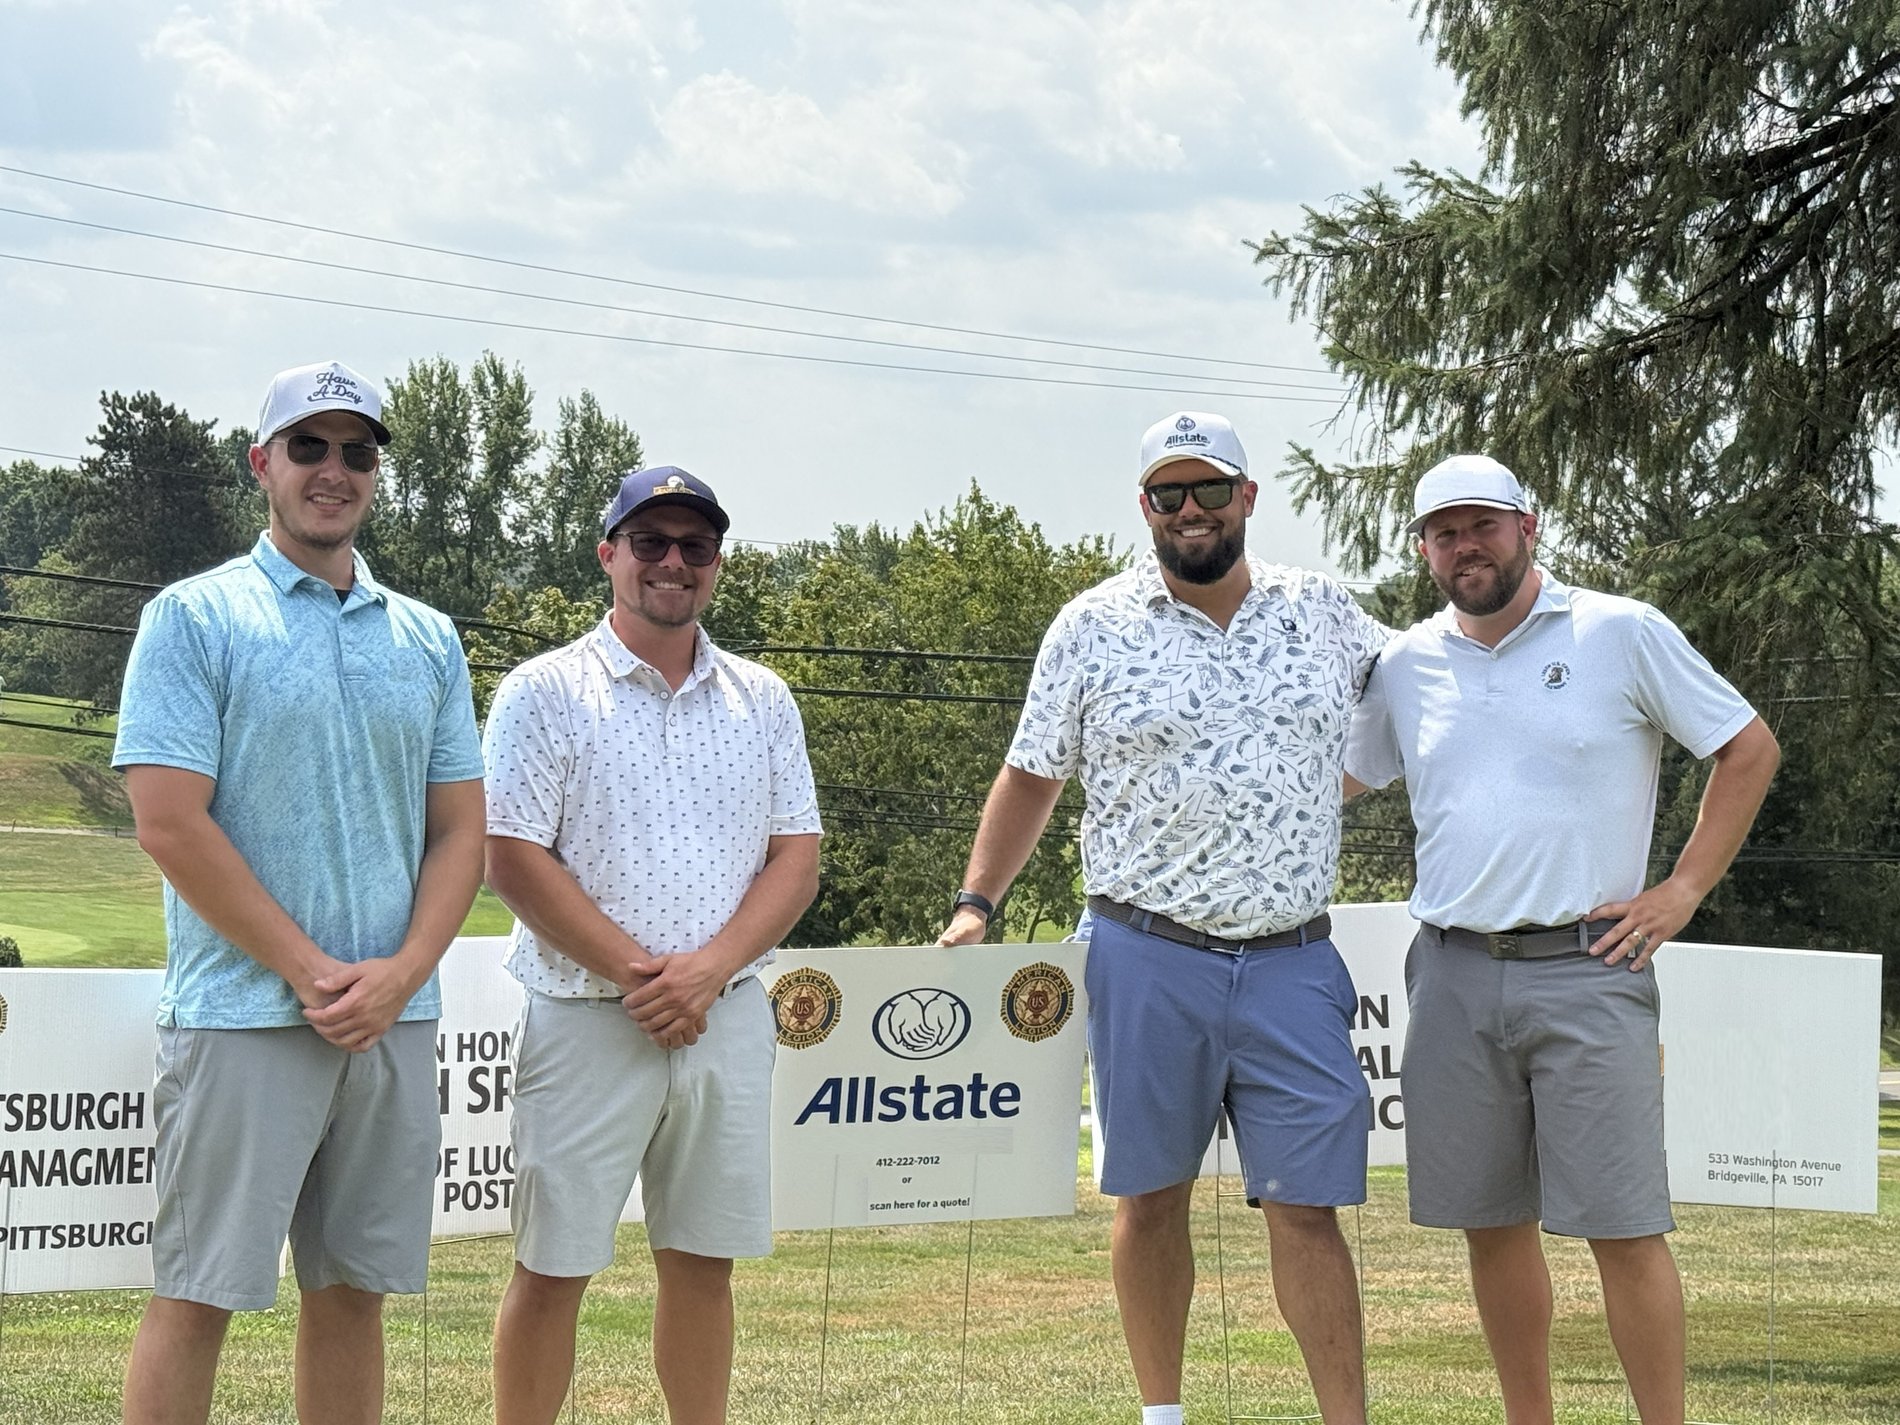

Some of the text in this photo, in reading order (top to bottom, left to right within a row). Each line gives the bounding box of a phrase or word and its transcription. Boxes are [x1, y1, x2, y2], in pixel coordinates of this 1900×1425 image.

[316, 372, 357, 389] Have
[313, 385, 363, 405] A Day
[775, 975, 834, 1000] AMERICAN
[1011, 970, 1067, 994] AMERICAN
[796, 1002, 811, 1015] US
[1031, 996, 1045, 1009] US
[779, 1027, 823, 1042] LEGION
[1015, 1021, 1057, 1035] LEGION
[793, 1072, 1021, 1126] Allstate
[0, 1091, 145, 1132] SBURGH
[436, 1148, 458, 1178] F
[876, 1156, 940, 1167] 412-222-7012
[1708, 1153, 1841, 1172] 533 Washington Avenue
[1708, 1169, 1824, 1187] Bridgeville, PA 15017
[443, 1179, 515, 1213] POST
[870, 1203, 892, 1211] scan
[894, 1200, 915, 1210] here
[917, 1199, 931, 1209] for
[940, 1197, 970, 1210] quote!
